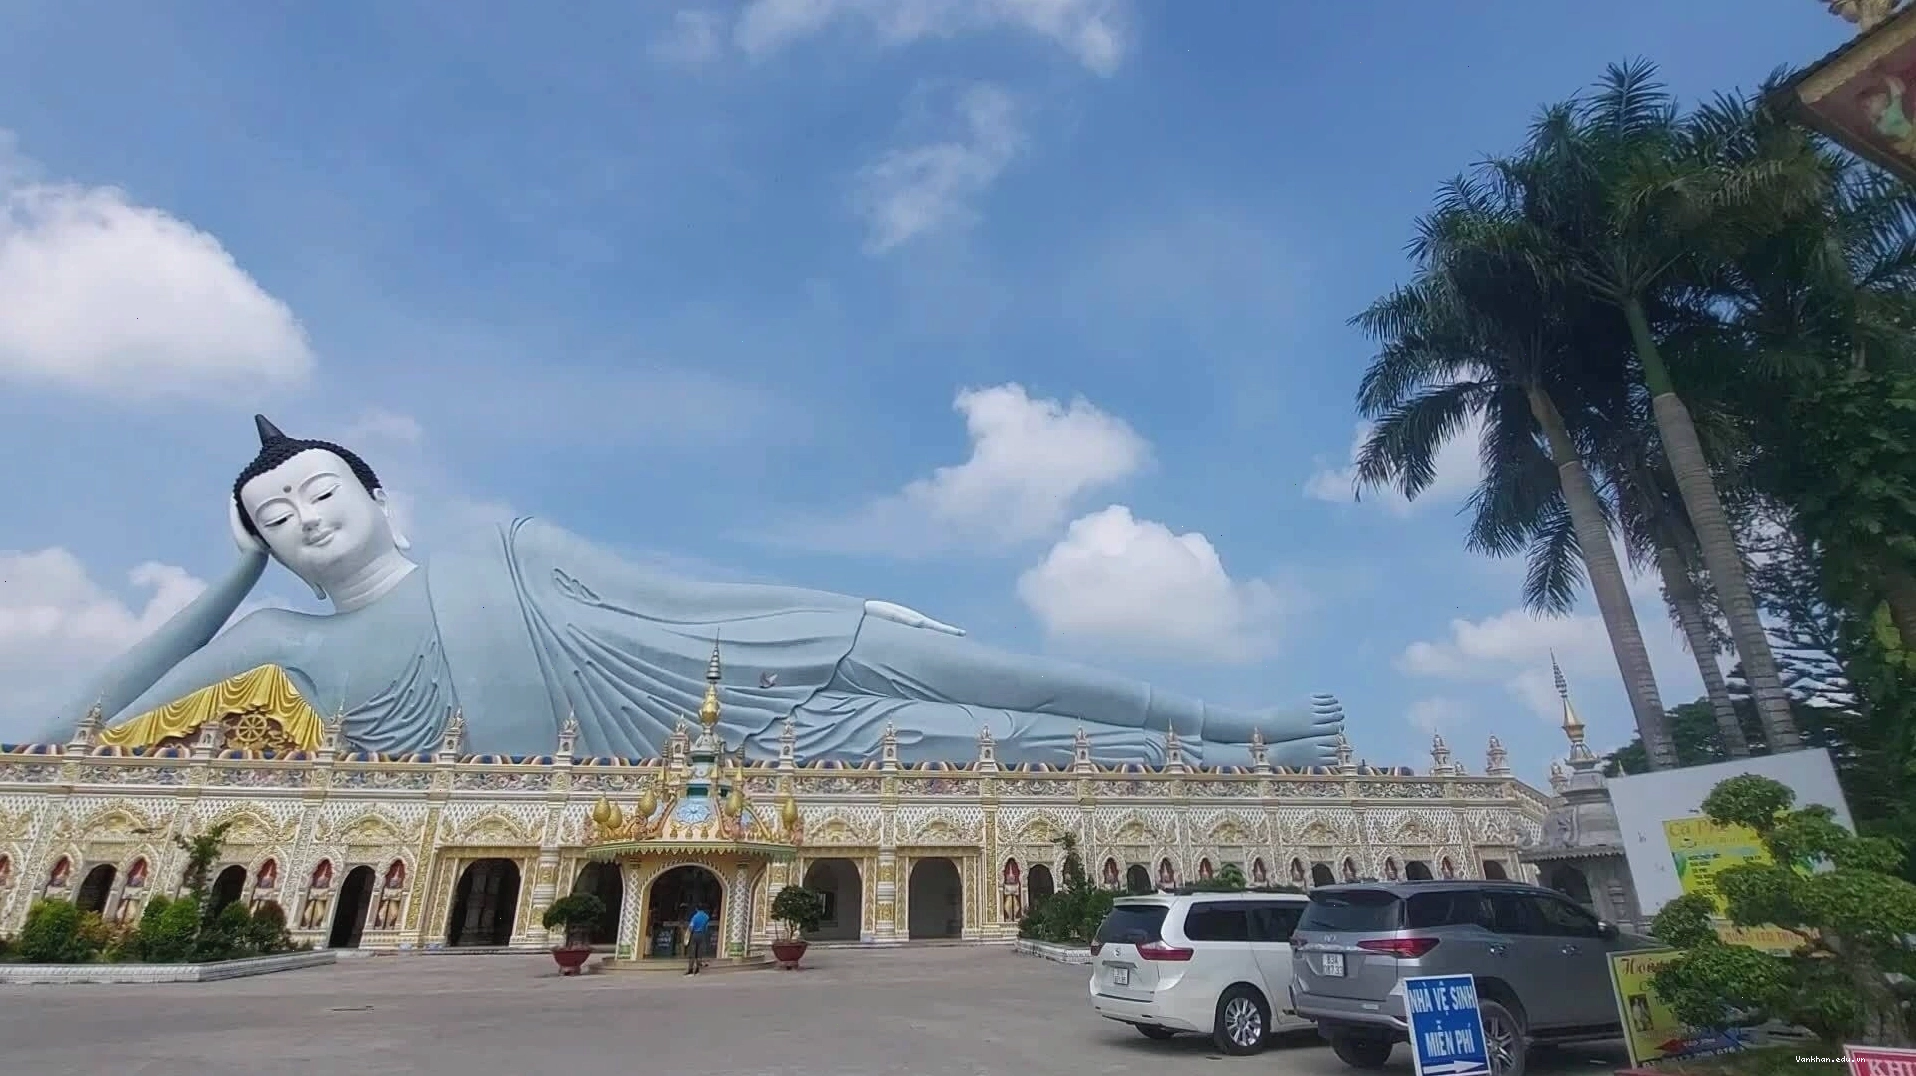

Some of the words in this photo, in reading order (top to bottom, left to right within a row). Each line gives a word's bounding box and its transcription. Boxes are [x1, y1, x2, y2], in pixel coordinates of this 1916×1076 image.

[1409, 981, 1434, 1013] NHÀ
[1432, 980, 1450, 1016] VỆ
[1449, 985, 1477, 1011] SINH
[1424, 1019, 1455, 1057] MIỄN
[1454, 1022, 1475, 1055] PHÍ
